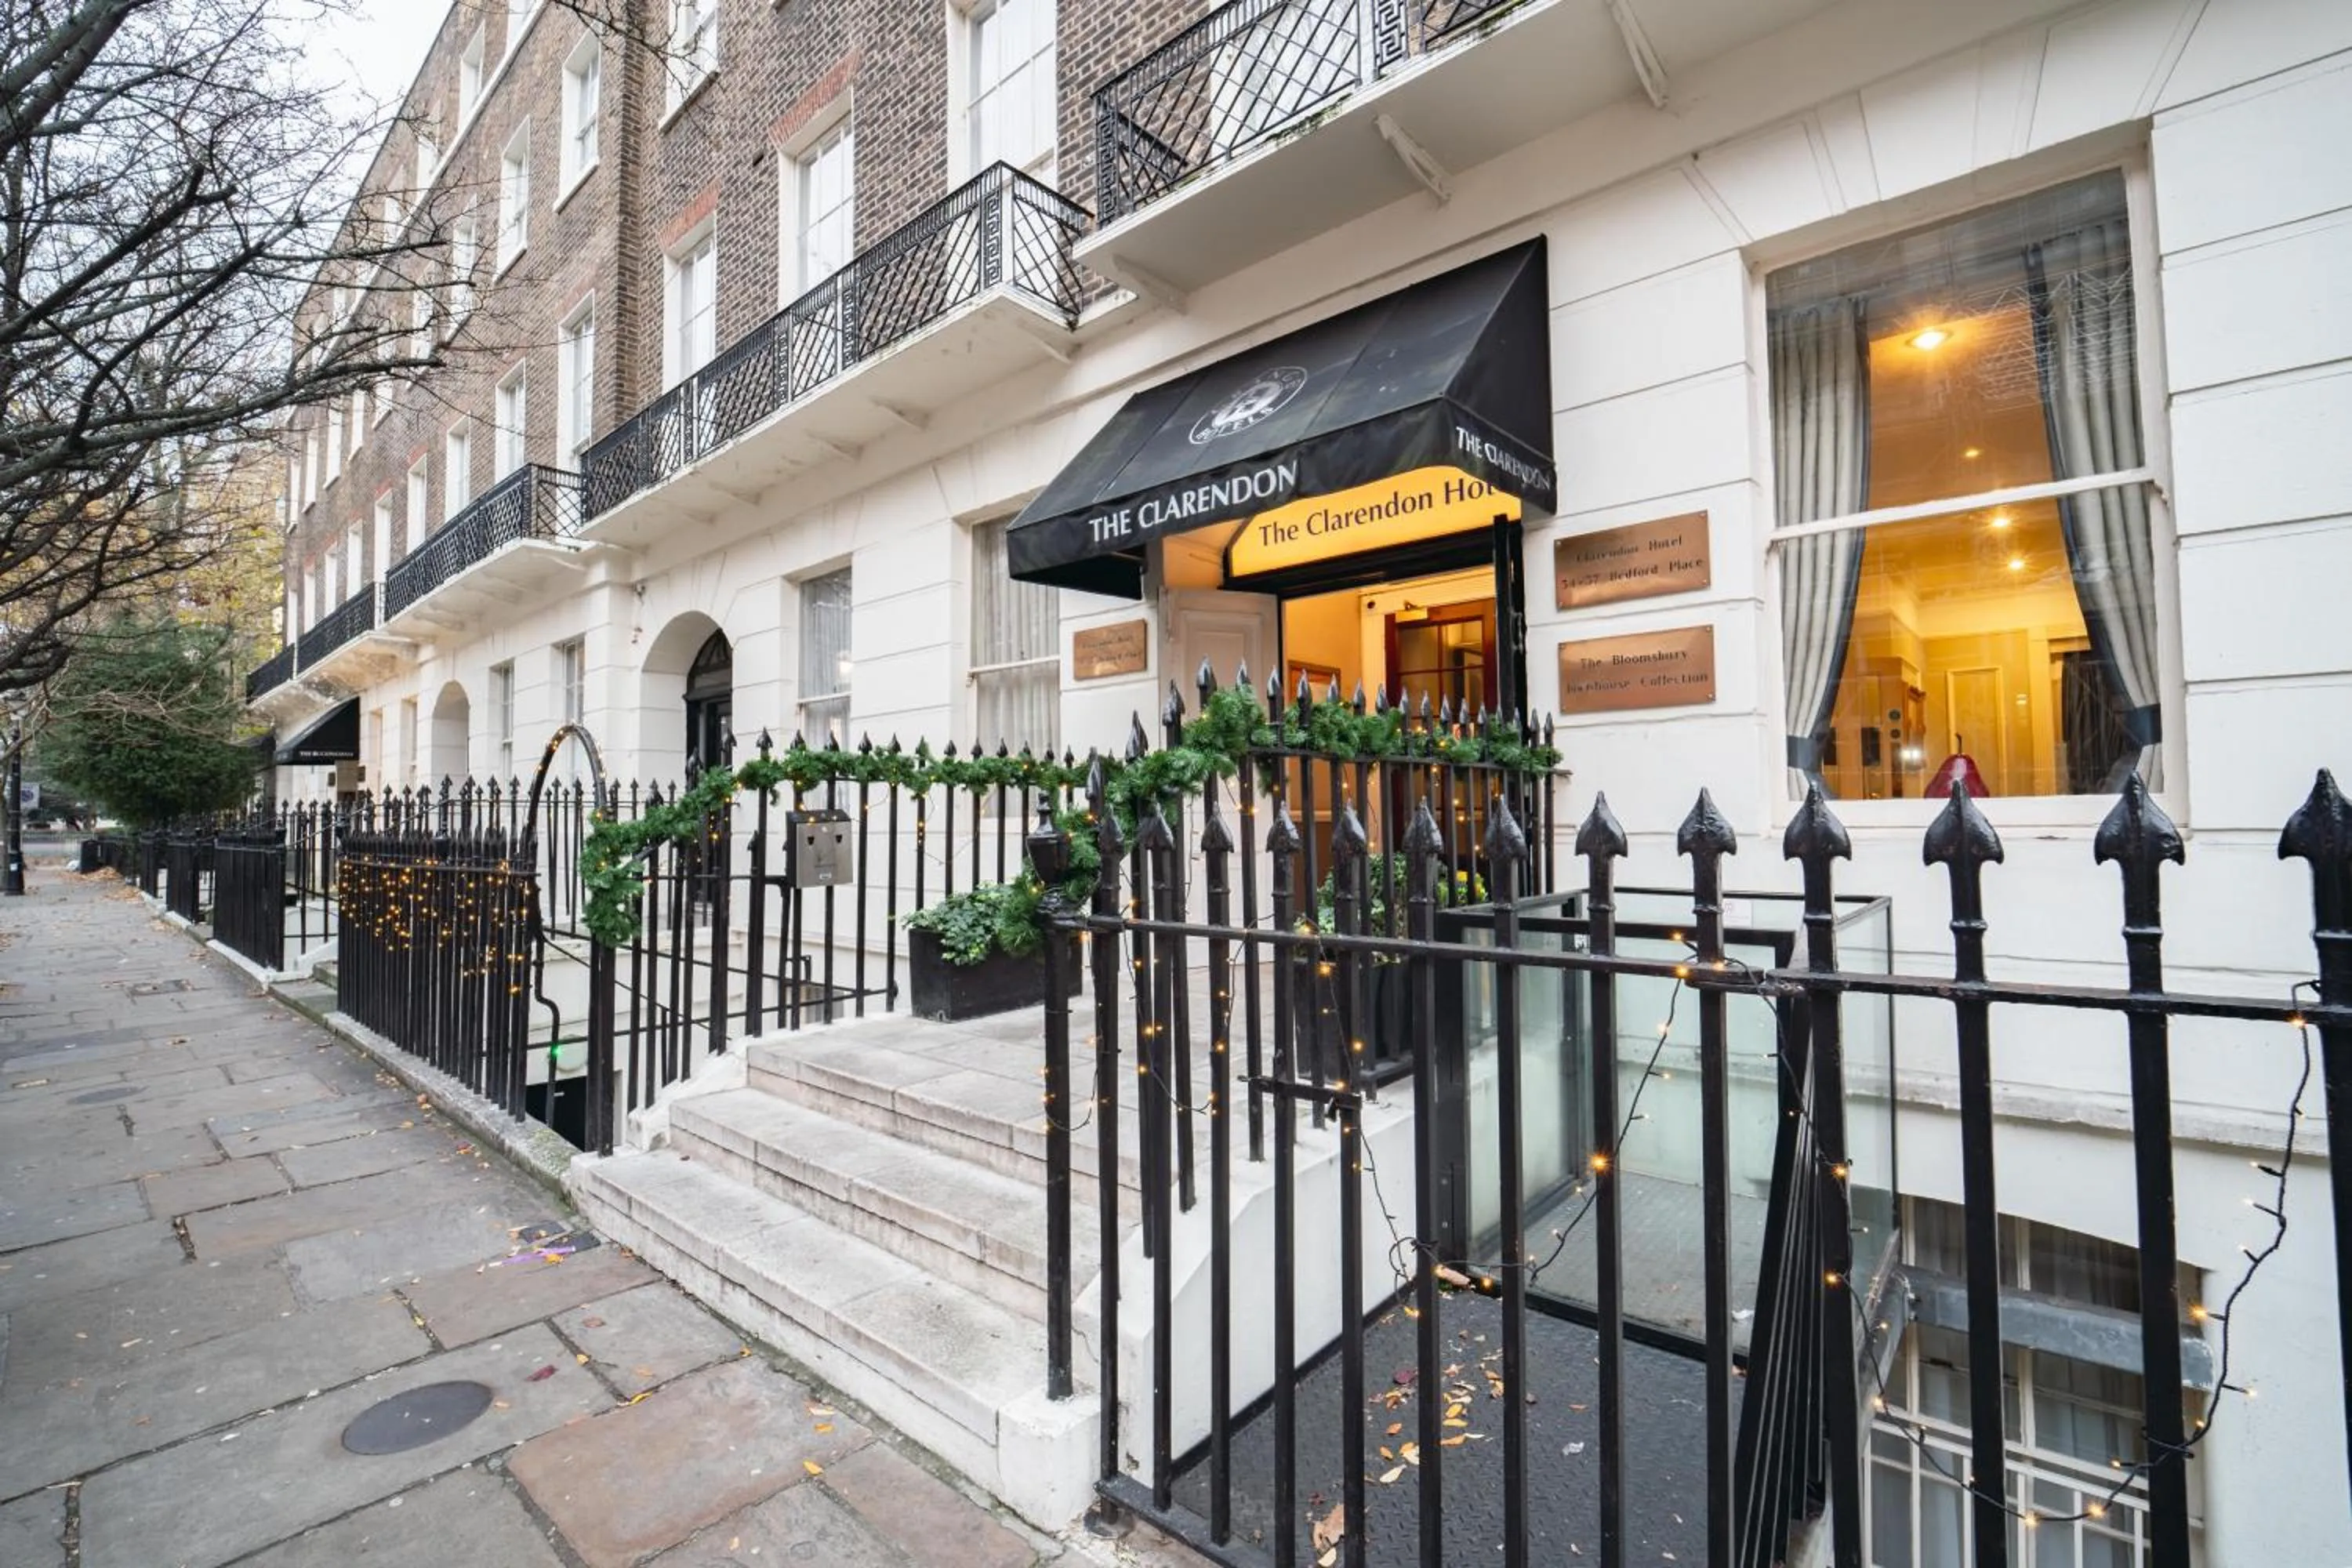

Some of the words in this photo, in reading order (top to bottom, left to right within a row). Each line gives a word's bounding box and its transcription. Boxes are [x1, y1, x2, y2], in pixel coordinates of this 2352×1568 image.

[1456, 426, 1483, 459] THE
[1088, 509, 1132, 543] THE
[1138, 459, 1298, 529] CLARENDON
[1258, 521, 1300, 546] The
[1306, 490, 1433, 535] Clarendon
[1444, 477, 1494, 505] Hot
[1648, 534, 1683, 551] Hotel
[1609, 564, 1659, 582] Bedford
[1669, 558, 1704, 574] Place
[1580, 657, 1602, 670] The
[1612, 649, 1689, 666] Bloomsbury
[1640, 672, 1709, 688] Collection
